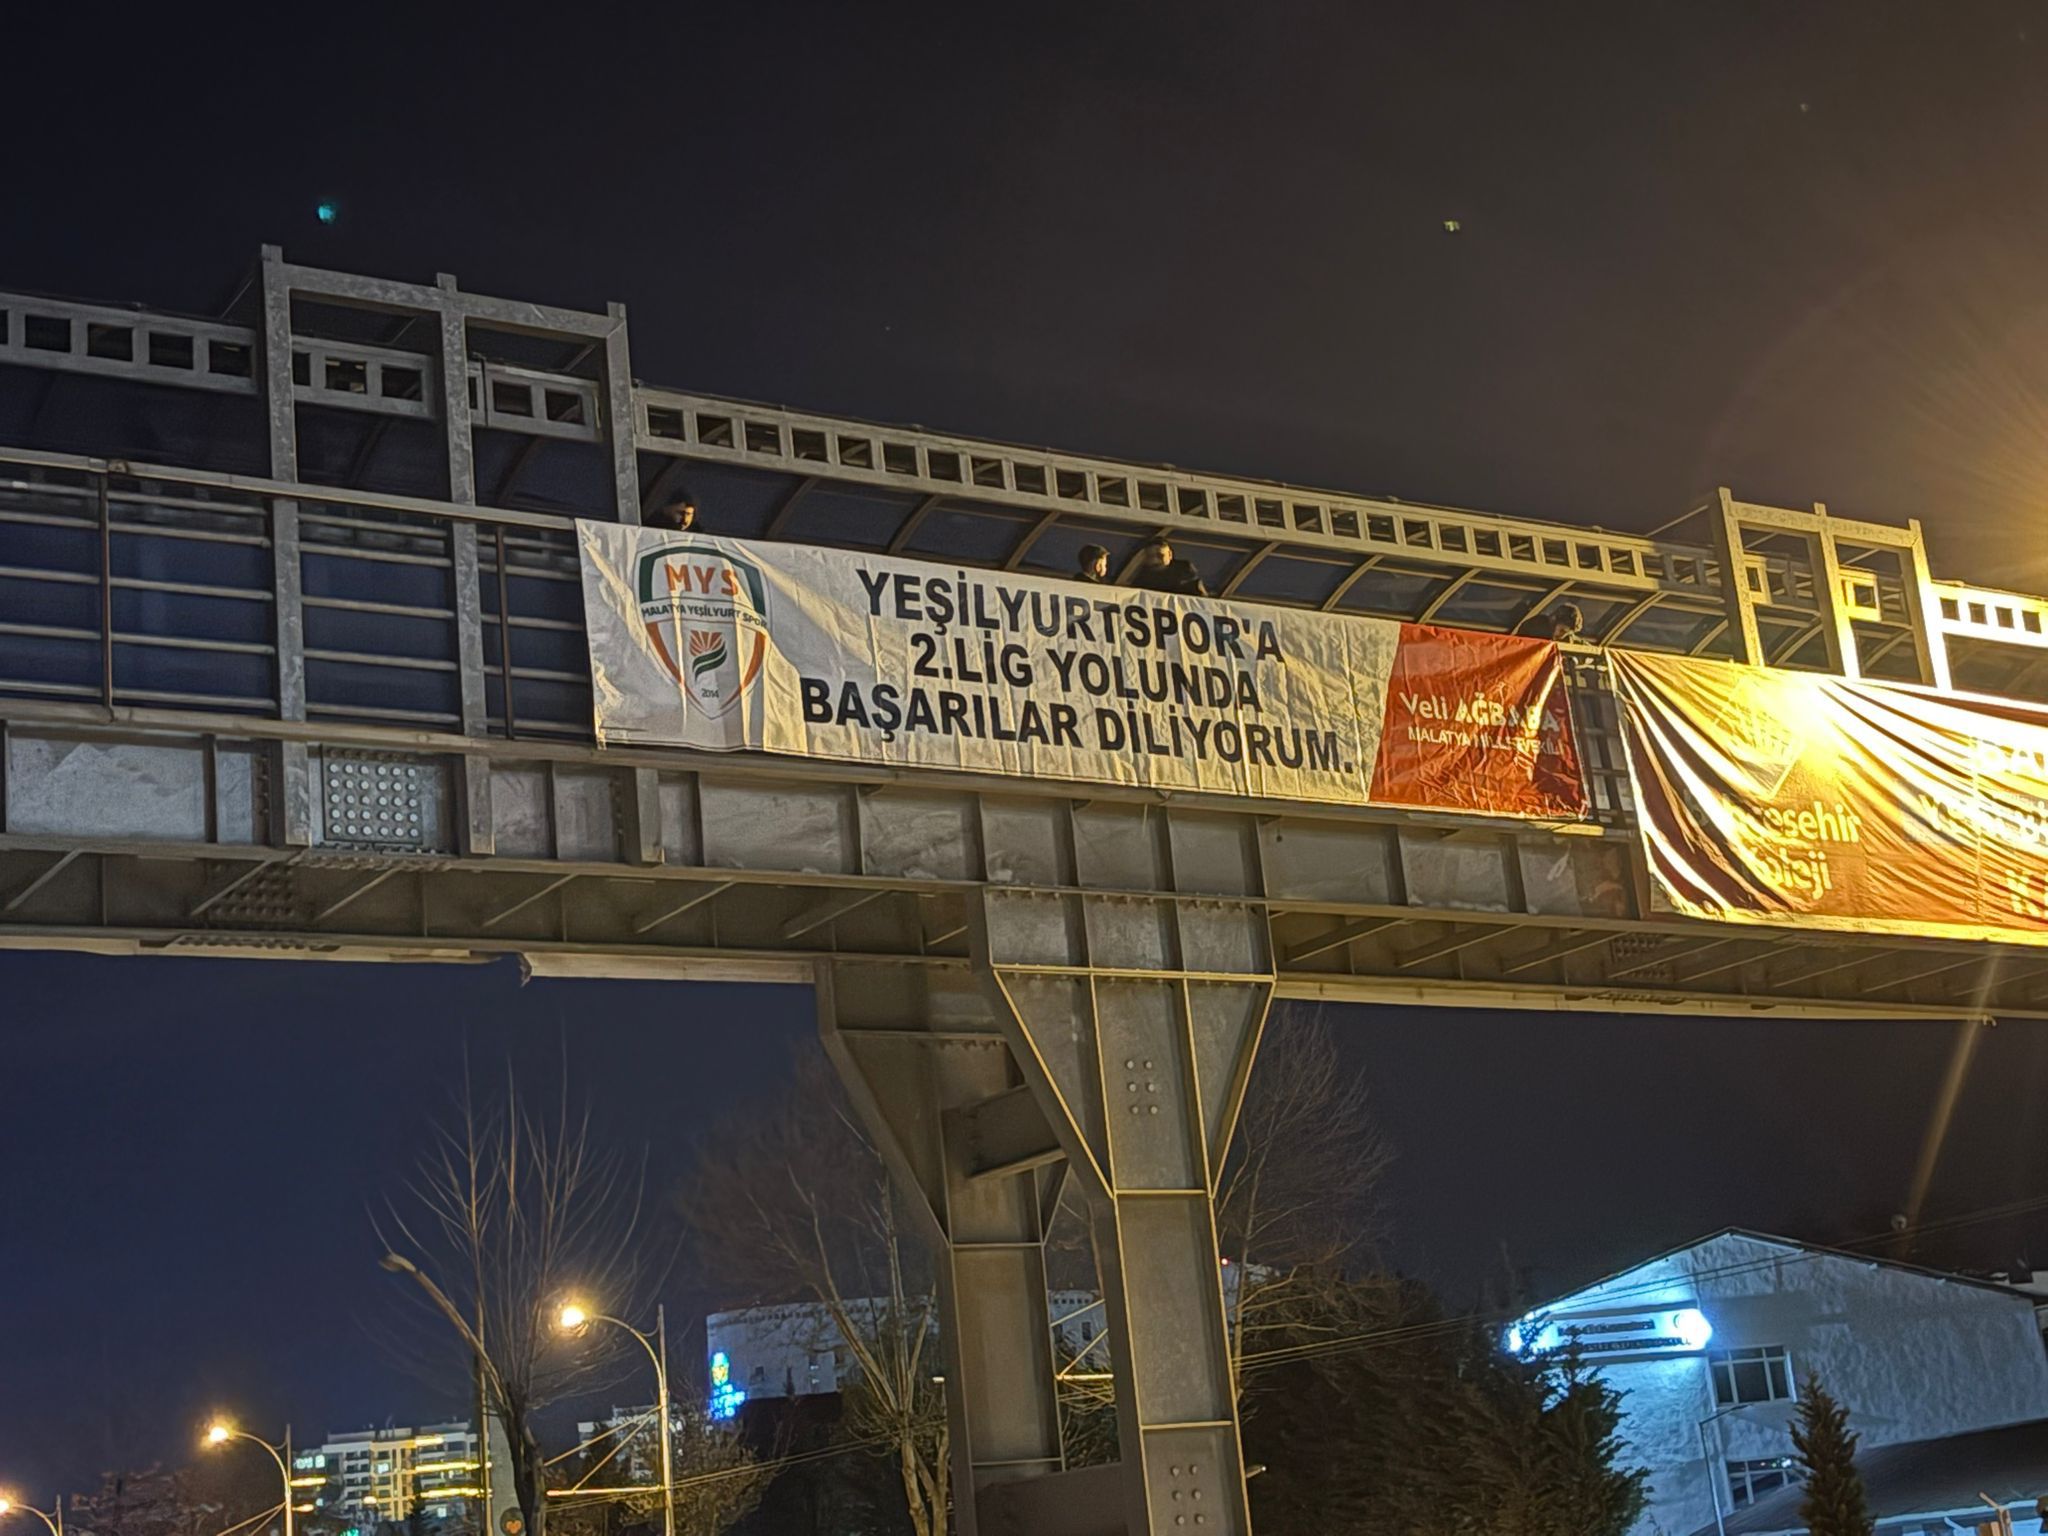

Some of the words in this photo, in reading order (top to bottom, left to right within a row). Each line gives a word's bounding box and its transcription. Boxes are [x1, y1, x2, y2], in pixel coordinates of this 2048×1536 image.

[664, 563, 739, 596] MYS
[641, 603, 687, 618] MALATYA
[856, 568, 1285, 663] YEŞİLYURTSPOR'A
[911, 630, 1033, 688] 2.LİG
[1046, 648, 1263, 713] YOLUNDA
[1399, 692, 1449, 721] Veli
[800, 677, 1084, 748] BAŞARILAR
[1096, 702, 1354, 774] DİLİYORUM.
[1408, 726, 1471, 747] MALATYA
